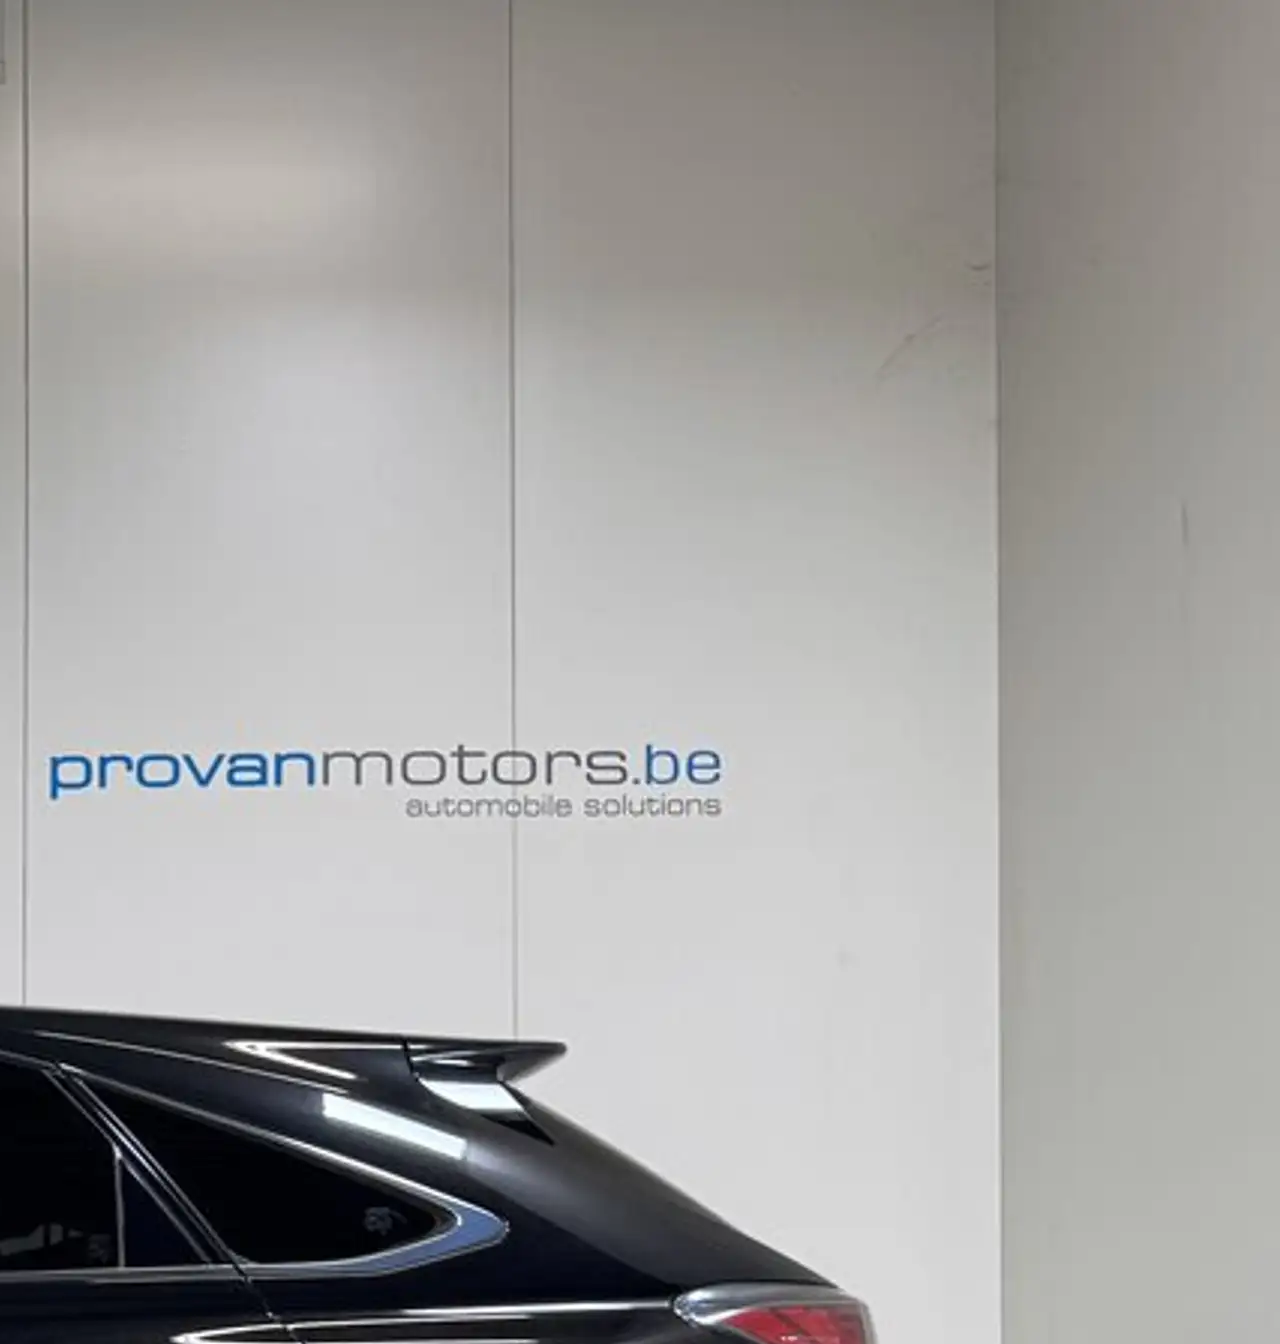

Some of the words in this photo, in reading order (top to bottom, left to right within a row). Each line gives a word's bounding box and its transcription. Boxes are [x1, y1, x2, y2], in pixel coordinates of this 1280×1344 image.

[48, 744, 722, 799] provanmotors.be
[405, 794, 573, 817] automobile
[584, 794, 722, 817] solutions
